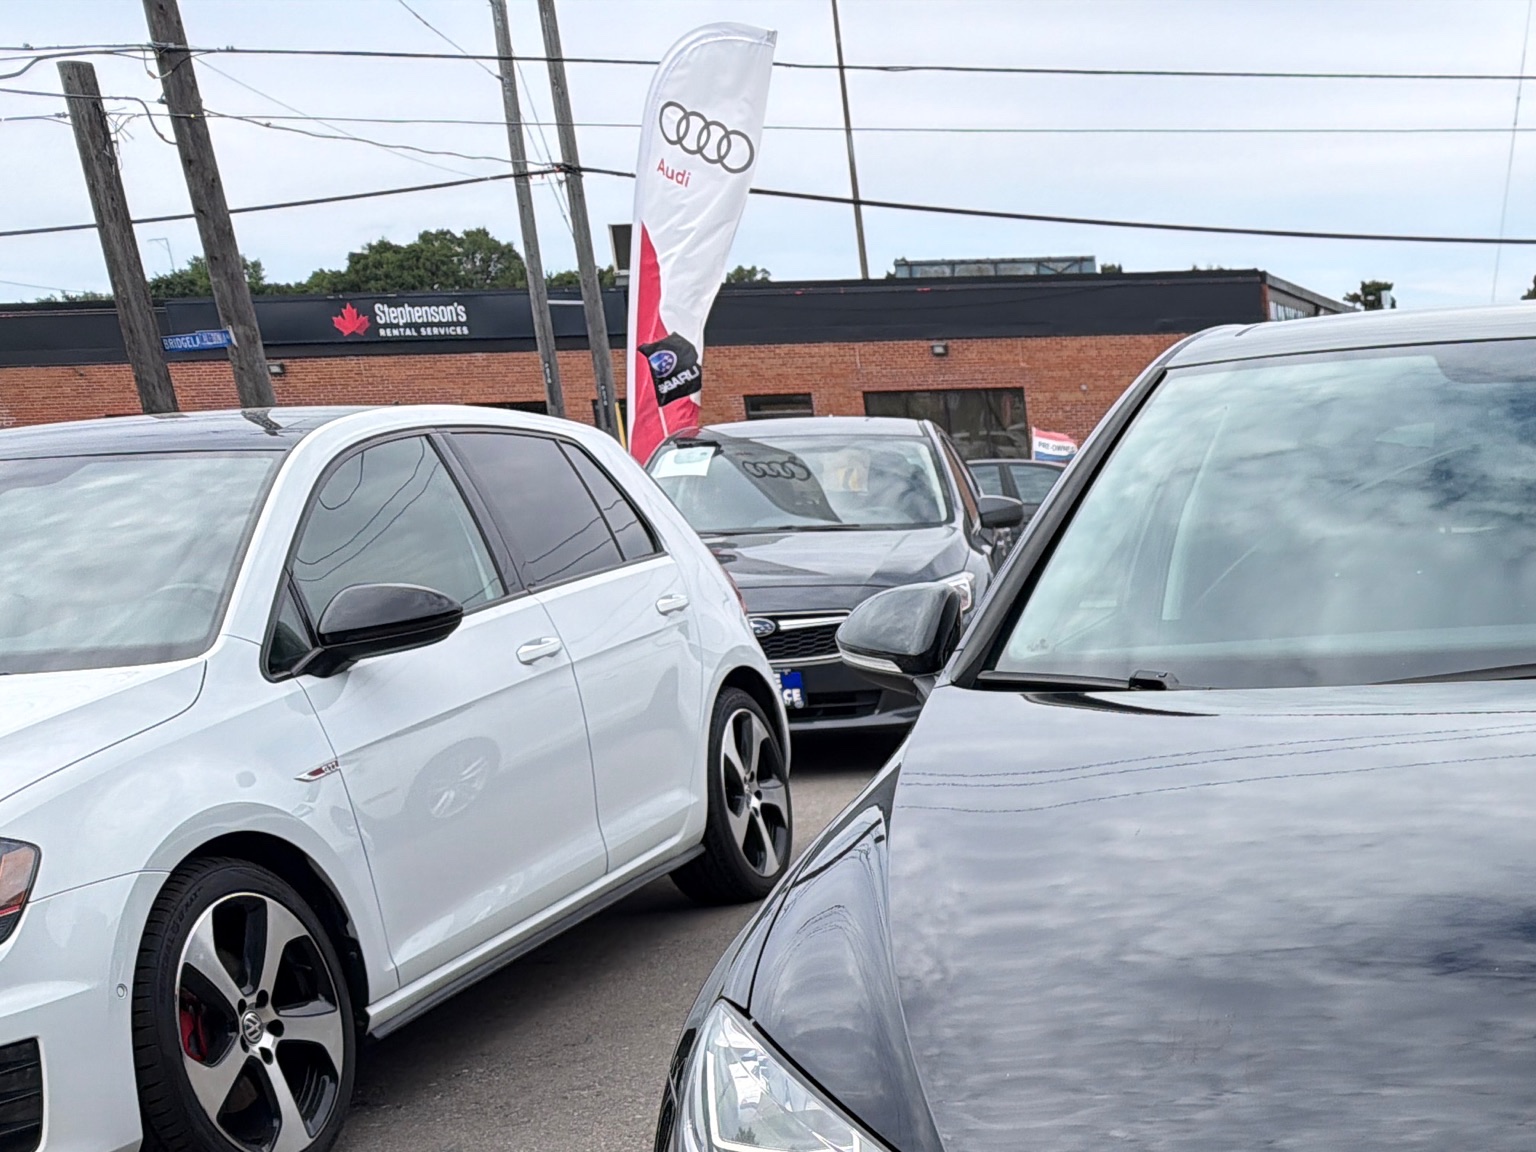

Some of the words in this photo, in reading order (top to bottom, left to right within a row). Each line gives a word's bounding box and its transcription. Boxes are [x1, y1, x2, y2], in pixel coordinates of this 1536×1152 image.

[657, 158, 691, 187] Audi
[374, 302, 467, 326] Stephenson's
[379, 328, 417, 337] RENTAL
[420, 326, 469, 336] SERVICES
